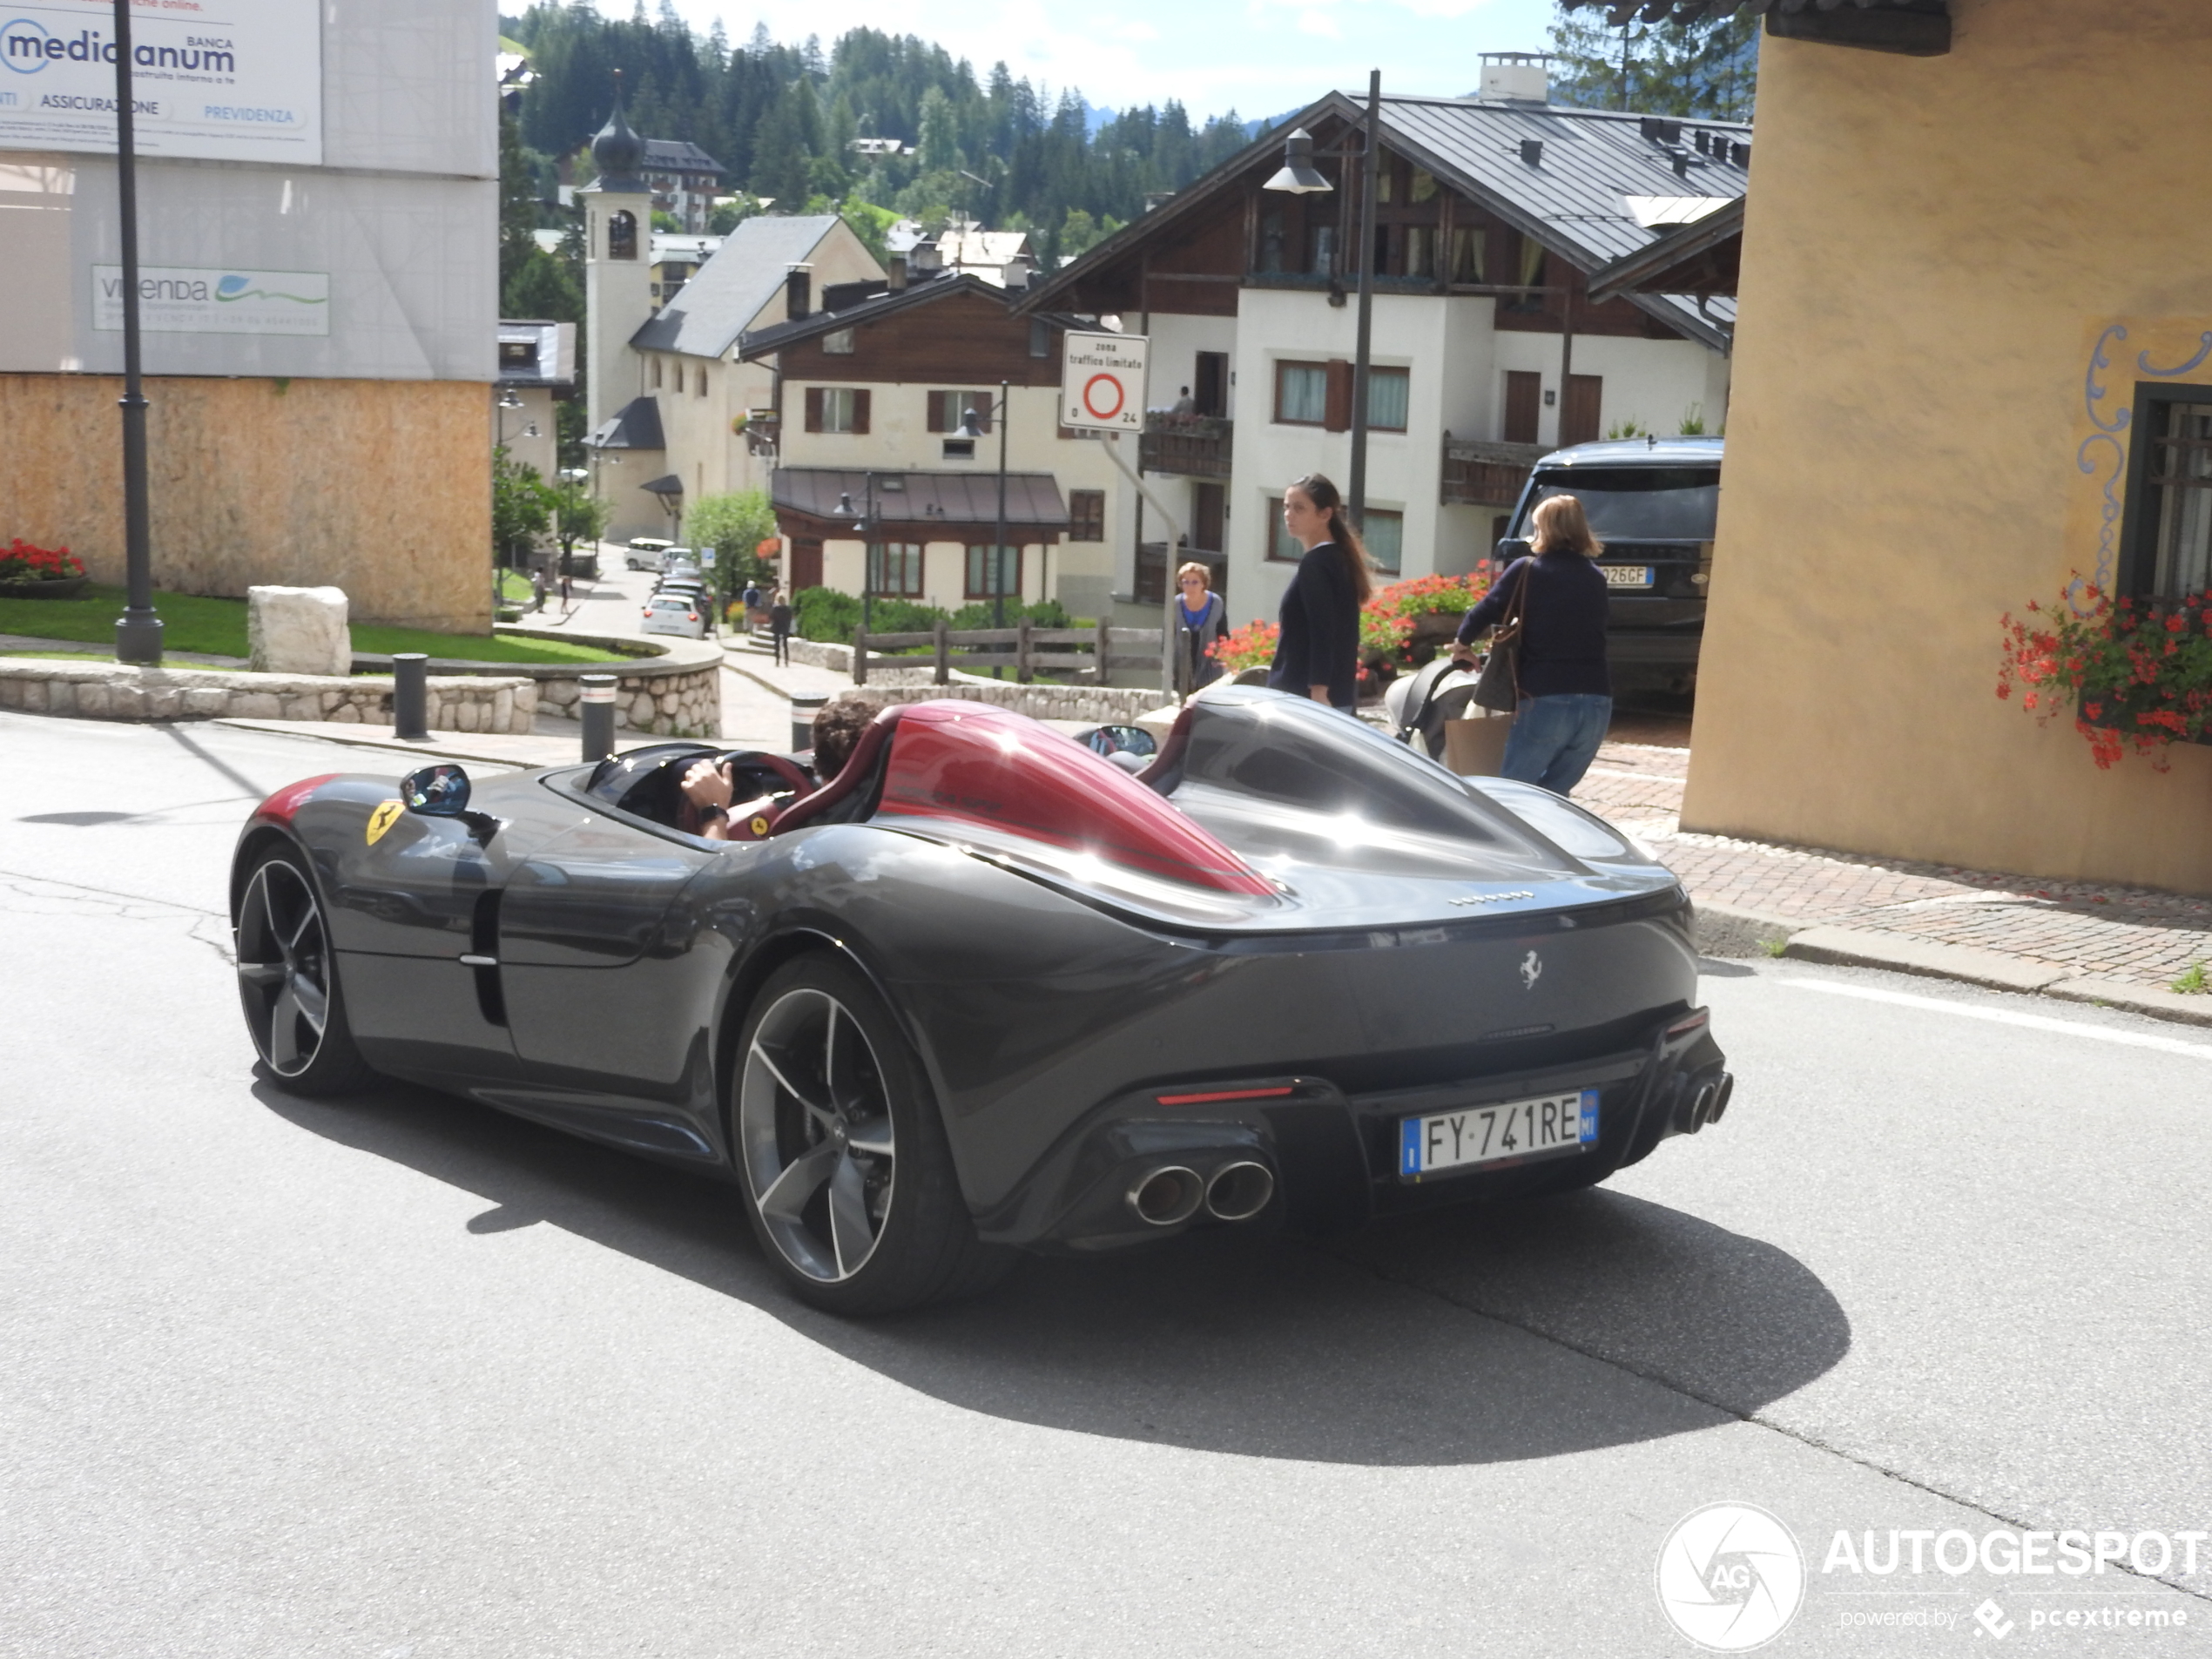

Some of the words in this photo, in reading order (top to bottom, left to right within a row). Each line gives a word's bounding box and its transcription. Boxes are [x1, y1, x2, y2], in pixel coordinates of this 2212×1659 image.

[187, 36, 234, 50] BANCA
[8, 30, 235, 72] medioanum
[205, 105, 294, 123] PREVIDENZA
[1096, 343, 1116, 352] zona
[1069, 354, 1103, 366] traffico
[1106, 356, 1142, 369] limitato
[1071, 408, 1078, 417] 0
[1123, 412, 1136, 423] 24
